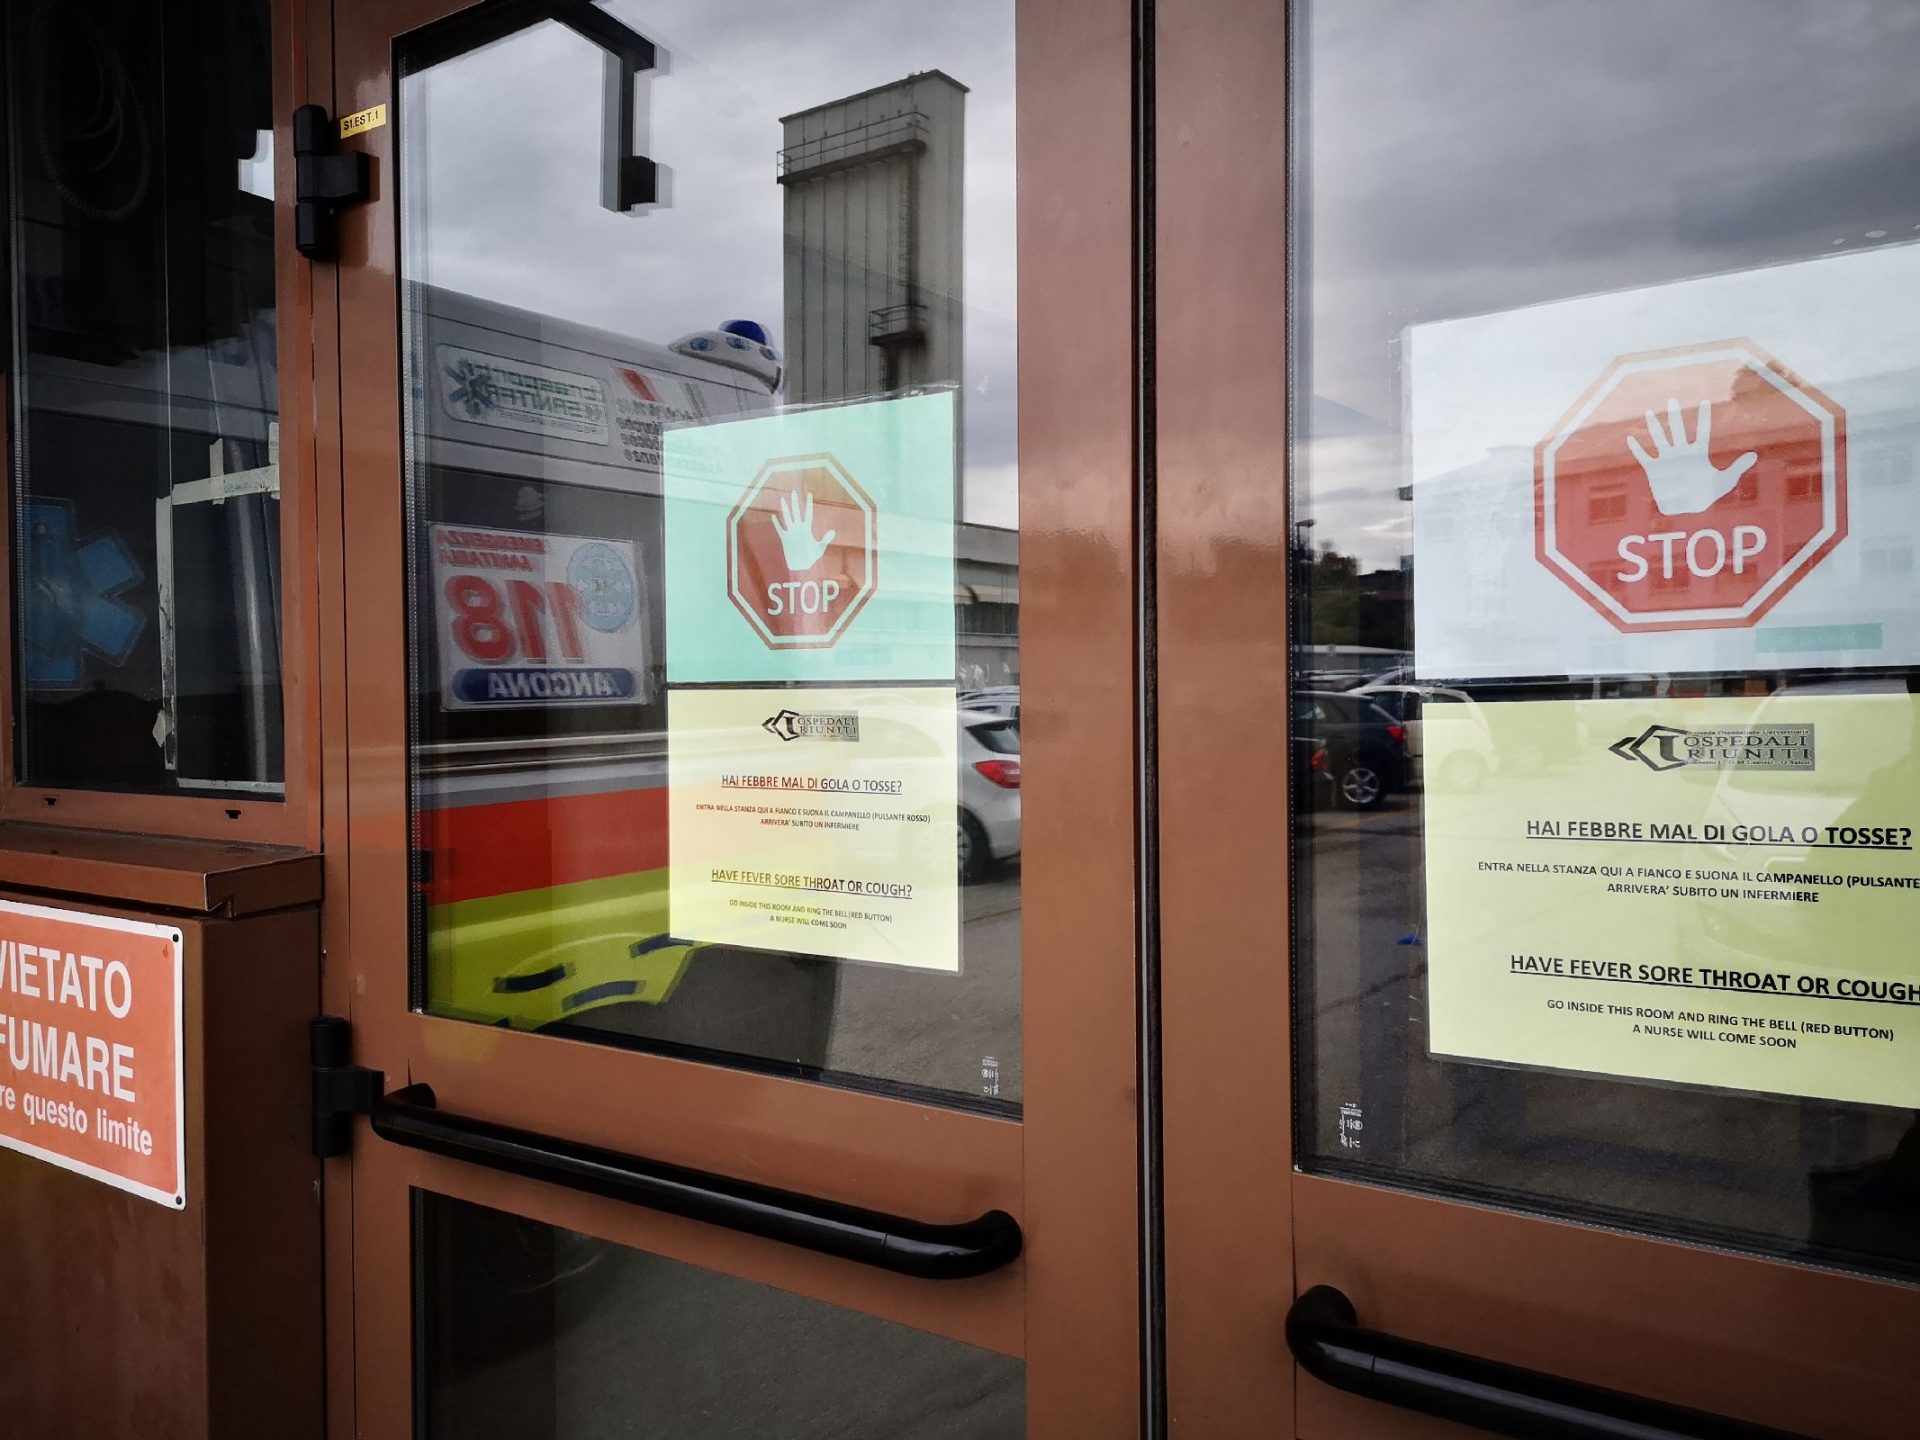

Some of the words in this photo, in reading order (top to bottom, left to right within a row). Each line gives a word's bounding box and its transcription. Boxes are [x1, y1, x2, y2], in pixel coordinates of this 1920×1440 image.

[1616, 525, 1767, 582] STOP
[767, 580, 839, 616] STOP
[798, 717, 855, 726] OSPEDALI
[800, 726, 856, 734] RIUNITI
[1684, 736, 1807, 747] OSPEDALI
[1688, 749, 1811, 759] RIUNITI
[722, 775, 738, 785] HAI
[742, 775, 778, 787] FEBBRE
[782, 777, 804, 788] MAL
[808, 778, 817, 788] DI
[821, 778, 849, 790] GOLA
[852, 780, 860, 790] O
[863, 780, 902, 792] TOSSE?
[824, 822, 859, 830] INFERMIERE
[831, 810, 870, 819] CAMPANELLO
[872, 812, 905, 821] (PULSANTE
[907, 814, 930, 824] ROSSO)
[1527, 820, 1560, 836] HAI
[1568, 821, 1643, 839] FEBBRE
[1650, 823, 1697, 840] MAL
[1704, 825, 1724, 841] DI
[1732, 826, 1794, 843] GOLA
[1801, 826, 1818, 844] O
[1825, 827, 1912, 846] TOSSE?
[712, 869, 738, 880] HAVE
[742, 871, 771, 884] FEVER
[774, 874, 800, 886] SORE
[803, 876, 845, 890] THROAT
[847, 880, 862, 892] OR
[866, 882, 912, 896] COUGH?
[1478, 862, 1513, 871] ENTRA
[1517, 863, 1550, 873] NELLA
[1553, 865, 1597, 875] STANZA
[1600, 866, 1622, 877] QUI
[1626, 867, 1634, 877] A
[1637, 868, 1681, 879] FIANCO
[1685, 870, 1692, 879] E
[1695, 870, 1738, 881] SUONA
[1743, 872, 1752, 882] IL
[1756, 872, 1843, 886] CAMPANELLO
[1847, 875, 1920, 889] (PULSANTE
[1673, 886, 1716, 897] SUBITO
[1721, 889, 1739, 898] UN
[1743, 890, 1819, 902] INFERMIERE
[739, 900, 757, 908] INSIDE
[773, 903, 790, 911] ROOM
[792, 905, 805, 913] AND
[807, 907, 820, 915] RING
[864, 913, 892, 923] BUTTON)
[796, 917, 809, 925] WILL
[811, 919, 828, 927] COME
[830, 921, 847, 929] SOON
[1511, 955, 1563, 973] HAVE
[1571, 959, 1632, 979] FEVER
[1638, 965, 1692, 983] SORE
[1699, 968, 1790, 991] THROAT
[1797, 976, 1829, 994] OR
[1547, 1000, 1564, 1009] GO
[1567, 1001, 1604, 1013] INSIDE
[1608, 1005, 1633, 1016] THIS
[1636, 1008, 1674, 1020] ROOM
[1678, 1012, 1704, 1023] AND
[1708, 1014, 1737, 1026] RING
[1742, 1017, 1765, 1028] THE
[1769, 1019, 1797, 1032] BELL
[1801, 1022, 1830, 1034] (RED
[1834, 1025, 1894, 1041] BUTTON)
[1633, 1024, 1641, 1033] A
[1644, 1025, 1683, 1038] NURSE
[1687, 1029, 1715, 1041] WILL
[1718, 1032, 1756, 1045] COME
[1759, 1036, 1796, 1048] SOON
[23, 1091, 88, 1134] questo
[96, 1107, 153, 1156] limite
